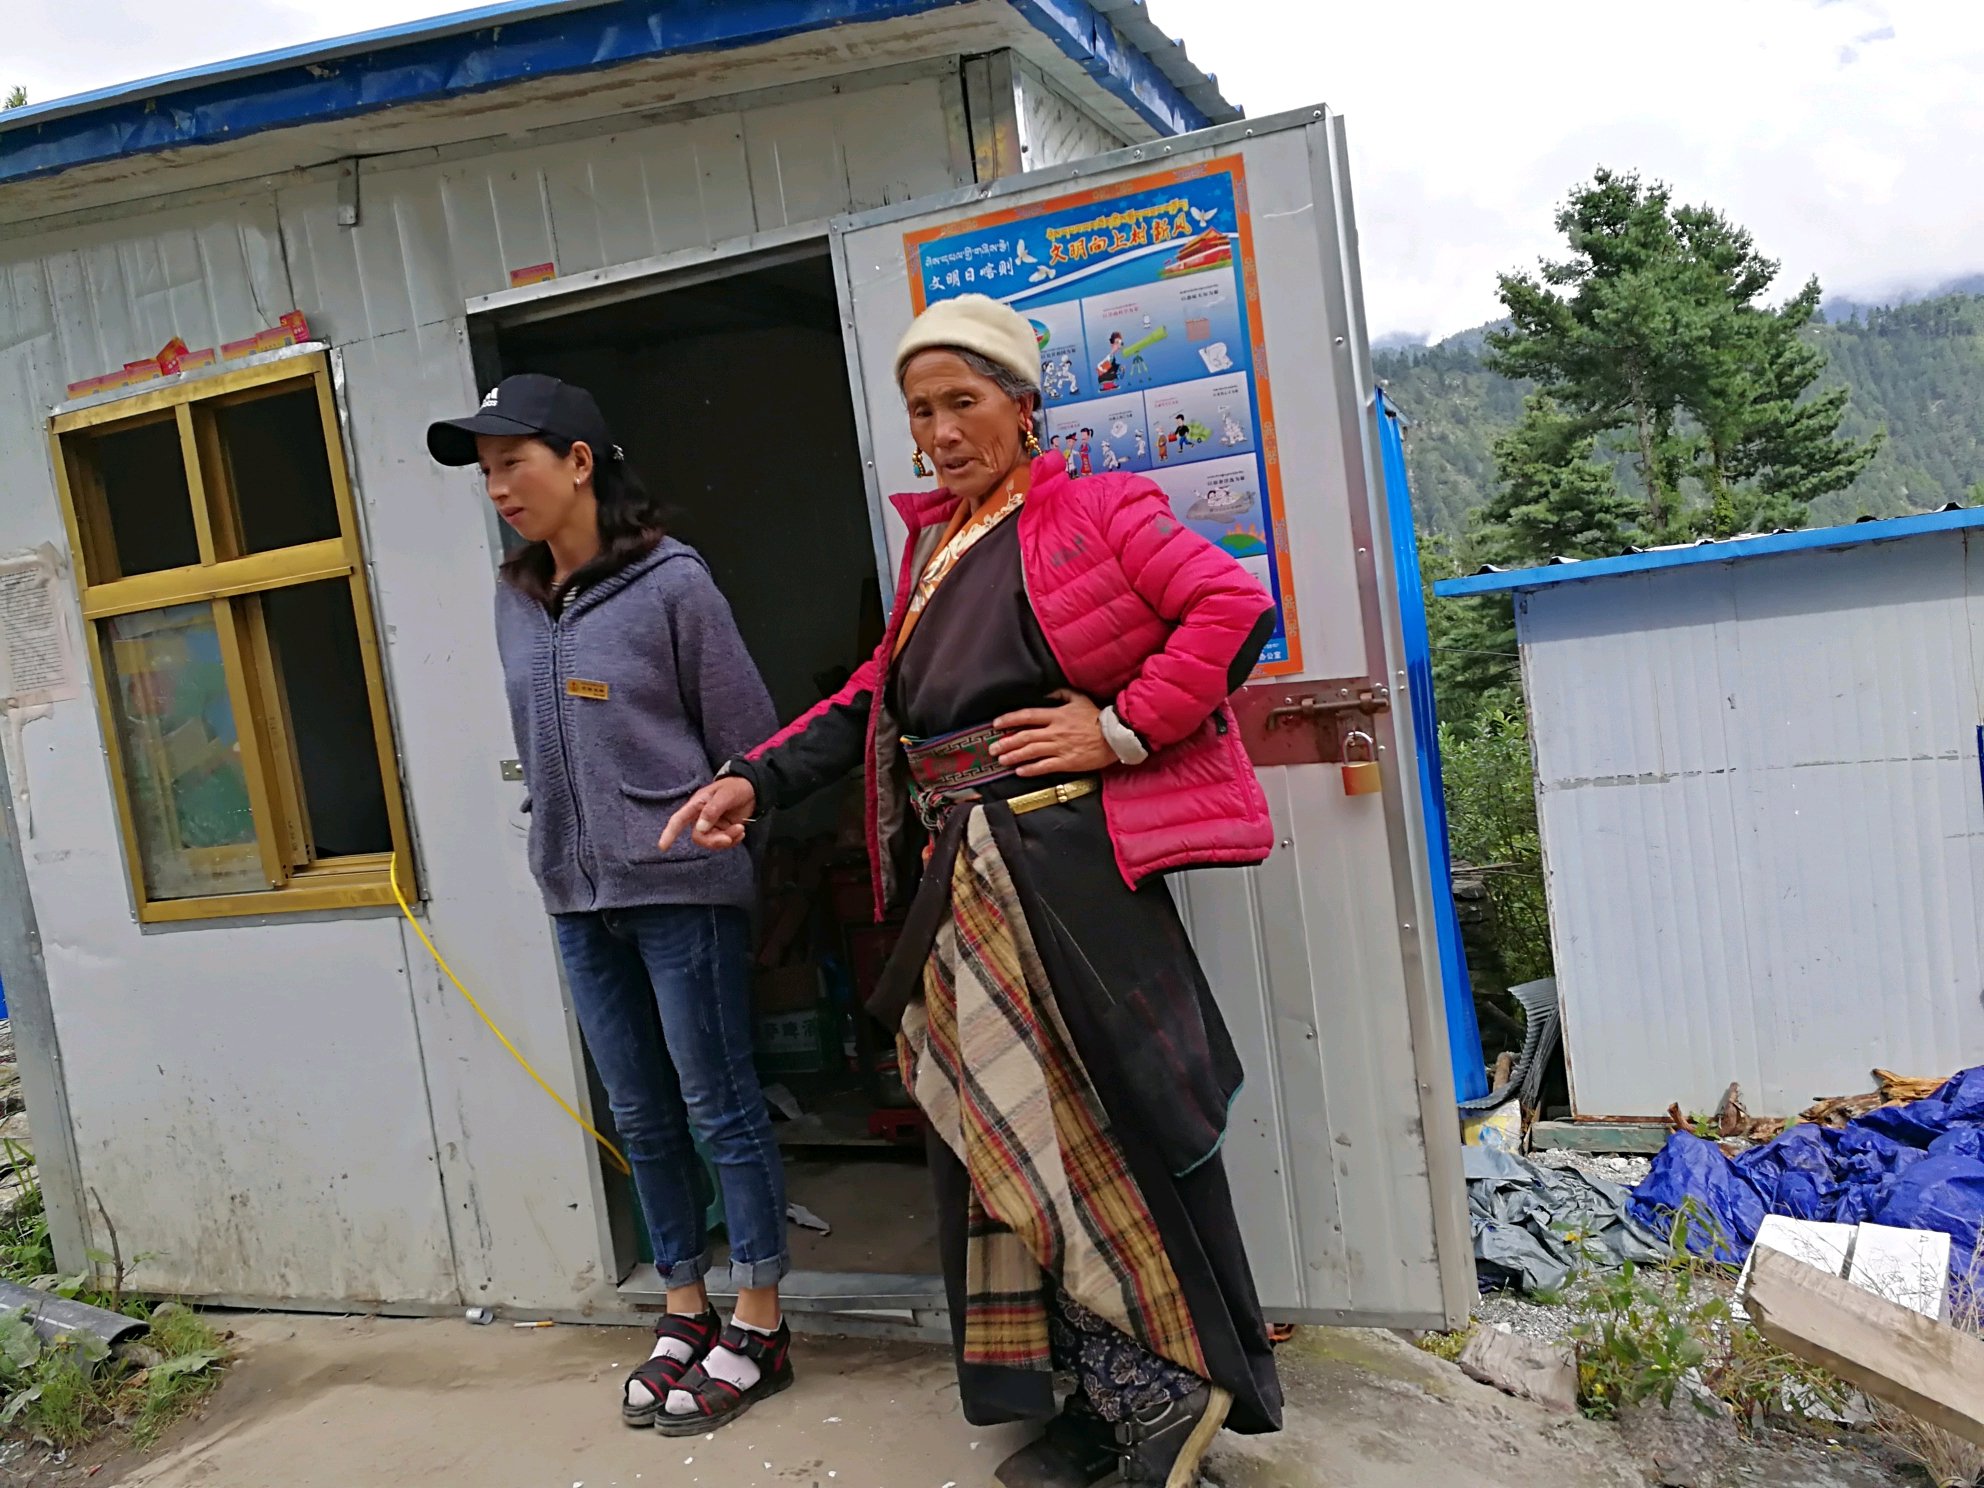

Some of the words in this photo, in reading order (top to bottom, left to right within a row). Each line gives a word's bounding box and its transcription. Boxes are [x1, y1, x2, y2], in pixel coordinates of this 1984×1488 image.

[1050, 212, 1192, 265] 文明向上树新风
[929, 257, 1014, 290] 文明日喀则
